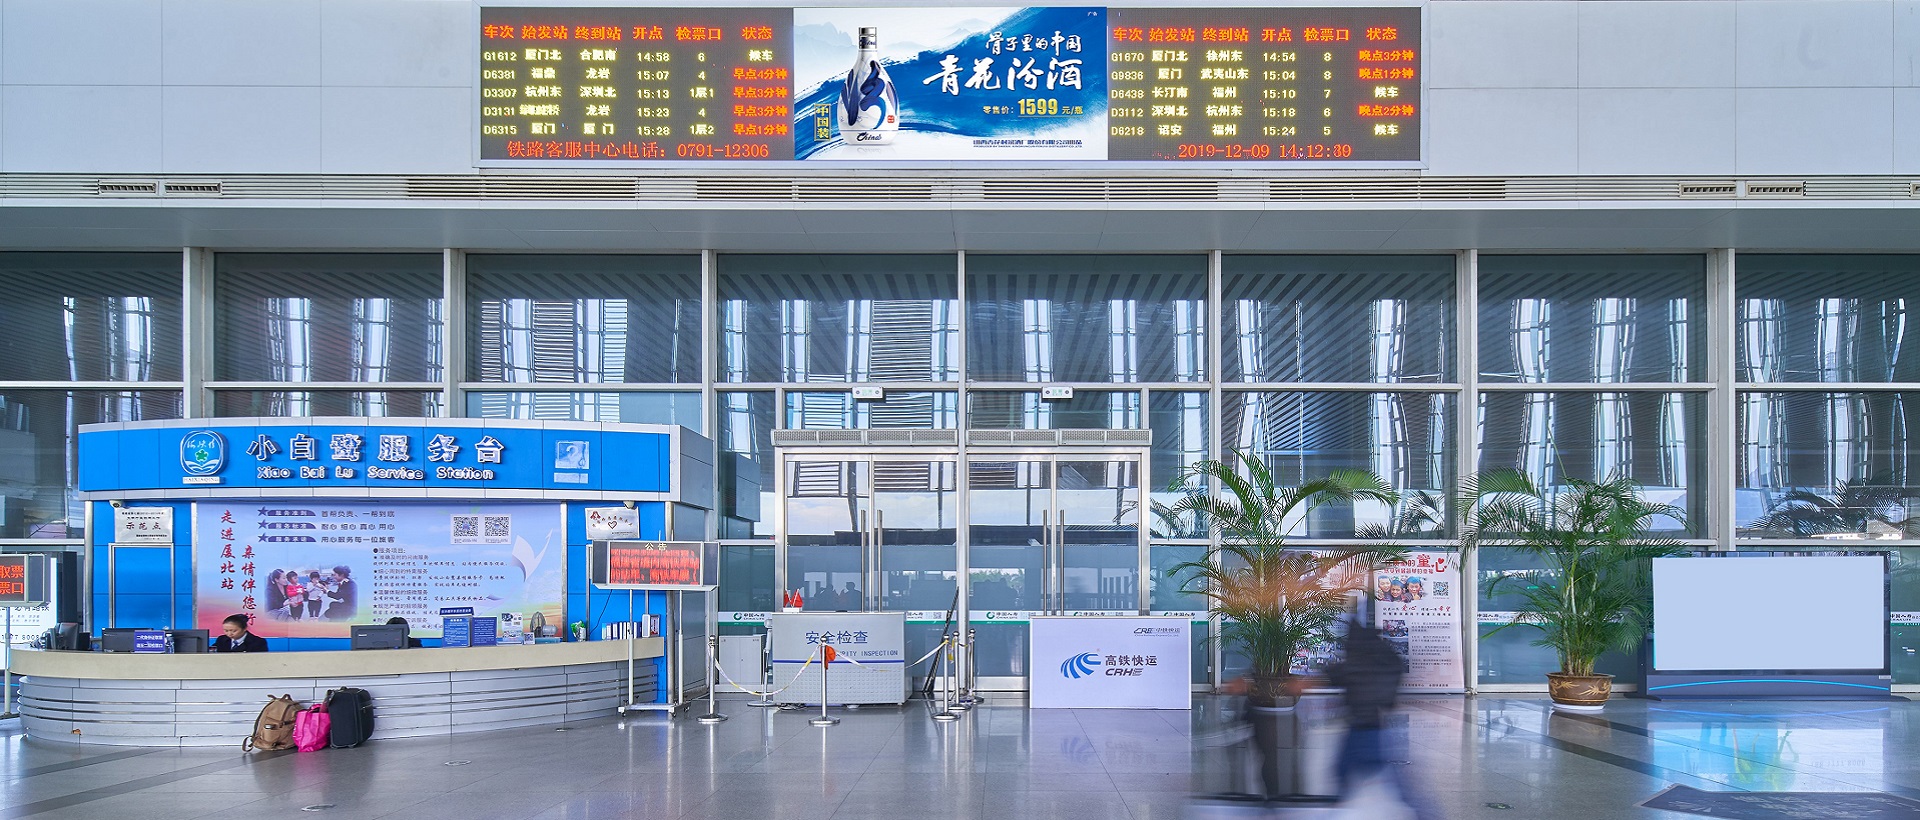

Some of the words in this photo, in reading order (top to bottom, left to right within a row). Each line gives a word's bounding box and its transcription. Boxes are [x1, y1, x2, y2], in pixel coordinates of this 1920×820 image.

[484, 25, 514, 40] 车次
[522, 25, 567, 40] 始发站
[575, 25, 621, 40] 终到站
[633, 26, 663, 40] 开点
[676, 27, 721, 40] 检票口
[742, 27, 772, 40] 状态
[1113, 27, 1143, 41] 车次
[1149, 27, 1195, 41] 始发站
[1203, 27, 1249, 41] 终到站
[1262, 28, 1292, 41] 开点
[1304, 27, 1349, 41] 检票口
[1367, 27, 1396, 40] 状态
[986, 30, 1082, 56] 骨子里的中国
[484, 52, 516, 61] G1612
[525, 49, 562, 61] 厦门北
[580, 49, 616, 61] 合肥南
[637, 52, 669, 61] 14:58
[698, 52, 705, 61] 6
[750, 50, 772, 61] 候车
[1112, 53, 1144, 62] G1670
[1152, 50, 1188, 62] 厦门北
[1206, 50, 1242, 62] 徐州东
[1263, 52, 1295, 62] 14:54
[1324, 52, 1331, 61] 8
[1359, 50, 1413, 61] 晚点3分钟
[484, 70, 515, 79] D6381
[531, 68, 555, 79] 福鼎
[586, 68, 610, 79] 龙岩
[637, 71, 669, 80] 15:07
[698, 71, 705, 80] 4
[734, 68, 787, 80] 早点4分钟
[923, 54, 1082, 96] 青花汾酒
[1112, 71, 1143, 80] G9836
[1159, 68, 1182, 79] 厦门
[1201, 68, 1249, 79] 武夷山东
[1263, 71, 1295, 80] 15:04
[1324, 71, 1331, 80] 8
[1359, 68, 1413, 80] 晚点1分钟
[484, 89, 517, 98] D3307
[525, 86, 562, 97] 杭州东
[580, 86, 616, 97] 深圳北
[637, 89, 669, 98] 15:13
[690, 87, 714, 98] 1层1
[734, 86, 787, 98] 早点3分钟
[1112, 89, 1144, 98] D6438
[1152, 87, 1188, 98] 长汀南
[1213, 87, 1236, 98] 福州
[1263, 89, 1295, 98] 15:10
[1324, 89, 1330, 98] 7
[1375, 87, 1398, 98] 候车
[484, 107, 515, 116] D3131
[586, 105, 610, 116] 龙岩
[637, 108, 669, 117] 15:23
[698, 108, 705, 117] 4
[734, 105, 787, 117] 早点3分钟
[1018, 98, 1058, 115] 1599
[1061, 106, 1083, 115] 元/瓶
[1112, 108, 1144, 117] D3112
[1152, 105, 1188, 117] 深圳北
[1206, 105, 1242, 117] 杭州东
[1263, 108, 1295, 117] 15:18
[1324, 108, 1330, 117] 6
[1359, 105, 1413, 116] 晚点2分钟
[484, 125, 517, 134] D6315
[531, 123, 555, 134] 厦门
[637, 126, 670, 136] 15:28
[690, 125, 714, 136] 1层2
[734, 123, 787, 135] 早点1分钟
[816, 107, 829, 139] 中国装
[1112, 126, 1144, 136] D6218
[1158, 124, 1182, 135] 诏安
[1213, 124, 1236, 135] 福州
[1263, 126, 1295, 136] 15:24
[1324, 126, 1330, 136] 5
[1375, 124, 1398, 135] 候车
[507, 141, 665, 158] 铁路客服中心电话：
[678, 143, 768, 158] 0791-12306
[1179, 144, 1270, 158] 2019-12-09
[246, 434, 504, 462] 小白鹭服务台
[258, 467, 290, 479] Xiao
[300, 466, 325, 479] Bai
[336, 466, 353, 478] Lu
[368, 466, 423, 480] Service
[436, 466, 493, 480] Station
[220, 509, 236, 590] 走进厦北站
[644, 542, 668, 552] 公告
[0, 581, 24, 594] 票口
[805, 630, 868, 645] 安全检查
[1105, 655, 1158, 667] 高铁快运
[1105, 668, 1144, 677] CRHE
